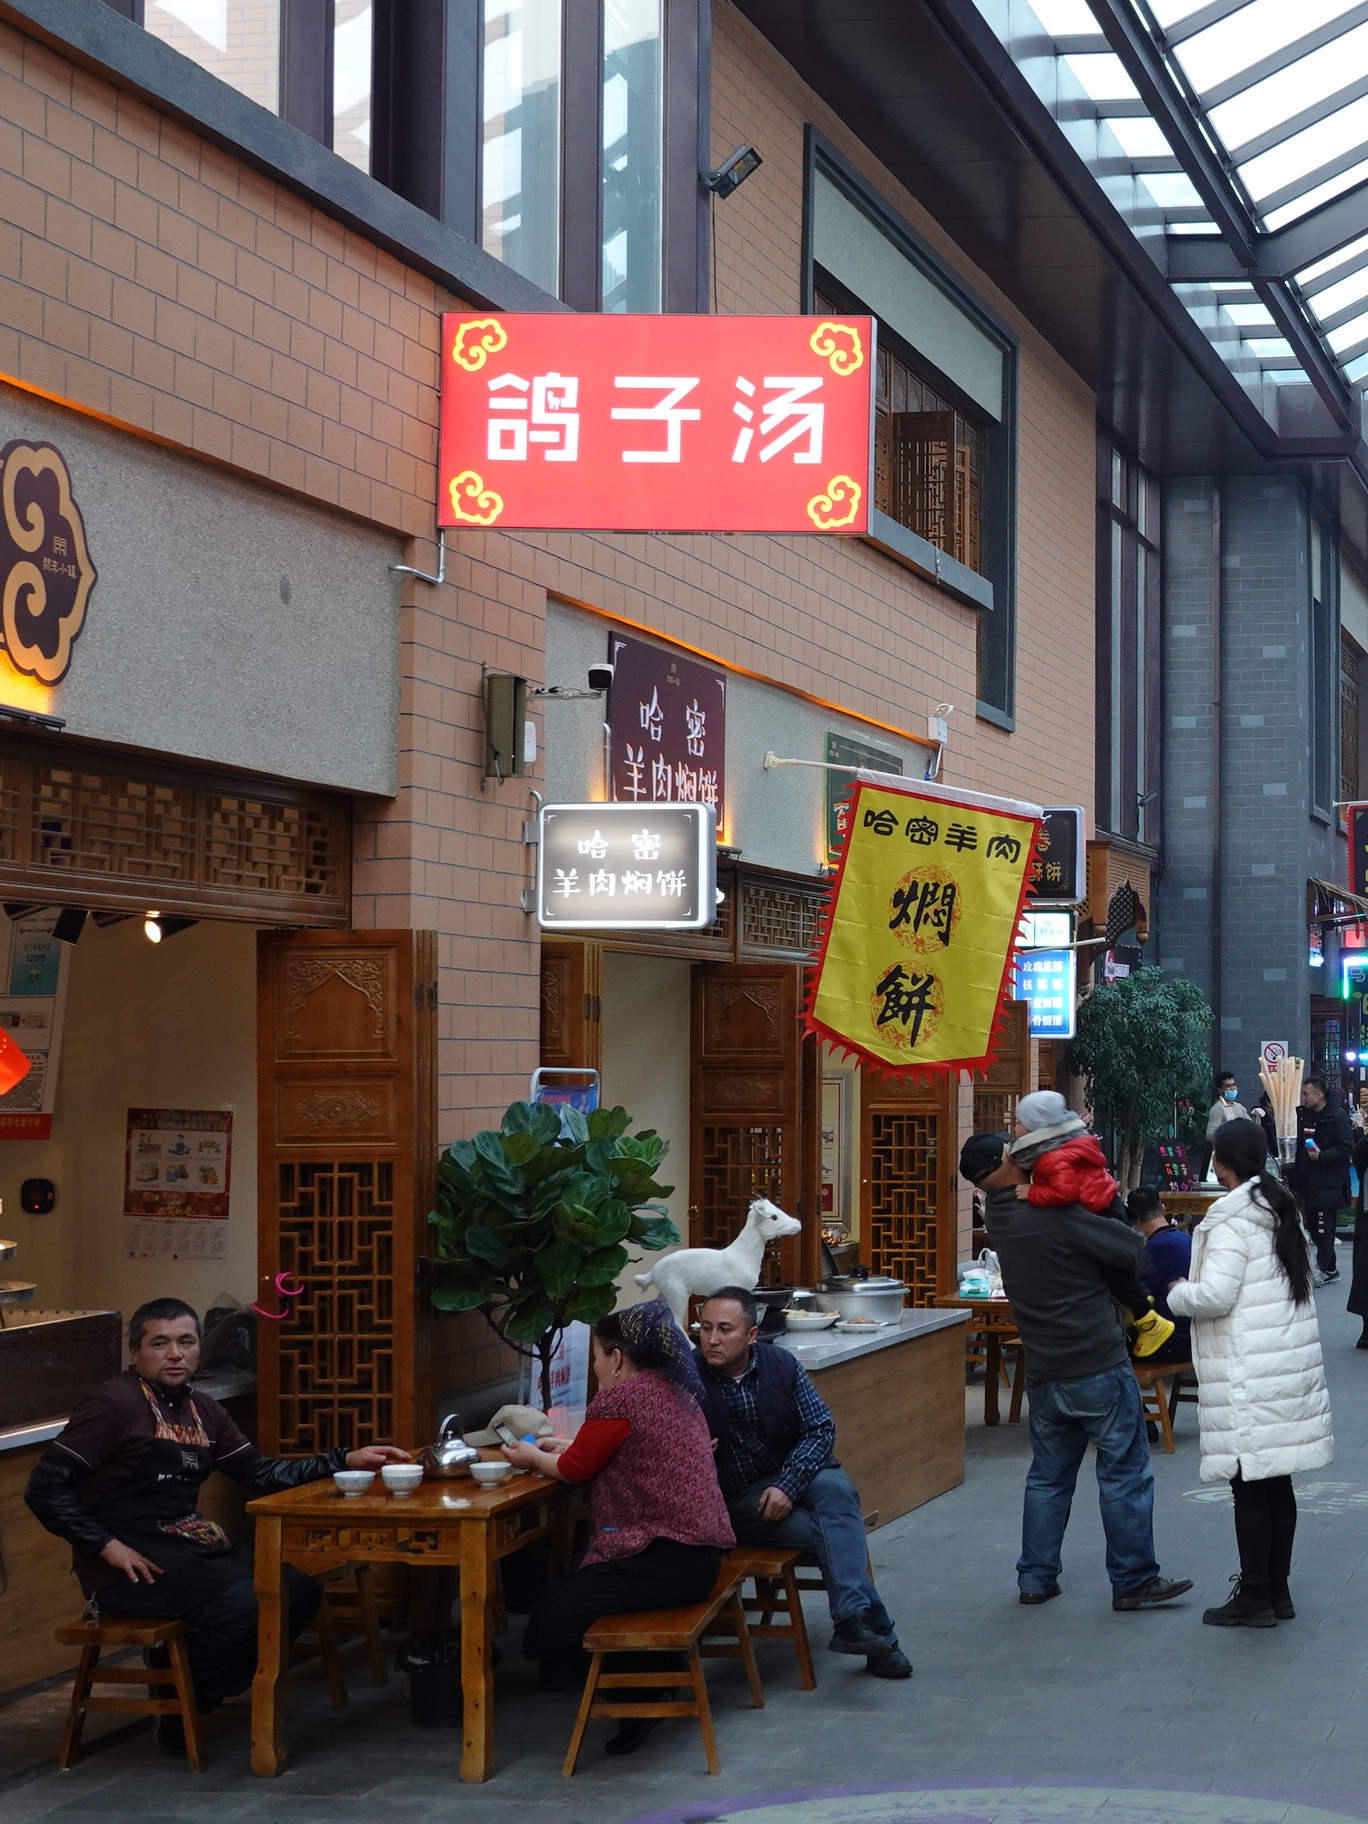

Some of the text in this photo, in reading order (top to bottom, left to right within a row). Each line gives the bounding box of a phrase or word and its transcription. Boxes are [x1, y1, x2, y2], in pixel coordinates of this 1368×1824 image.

[486, 371, 825, 464] 鸽子汤
[639, 685, 706, 757] 哈密
[622, 742, 719, 807] 羊肉焖饼
[577, 828, 661, 861] 哈密
[862, 807, 1023, 864] 哈密羊肉
[552, 867, 688, 899] 羊肉焖饼
[876, 879, 957, 1048] 燜餅
